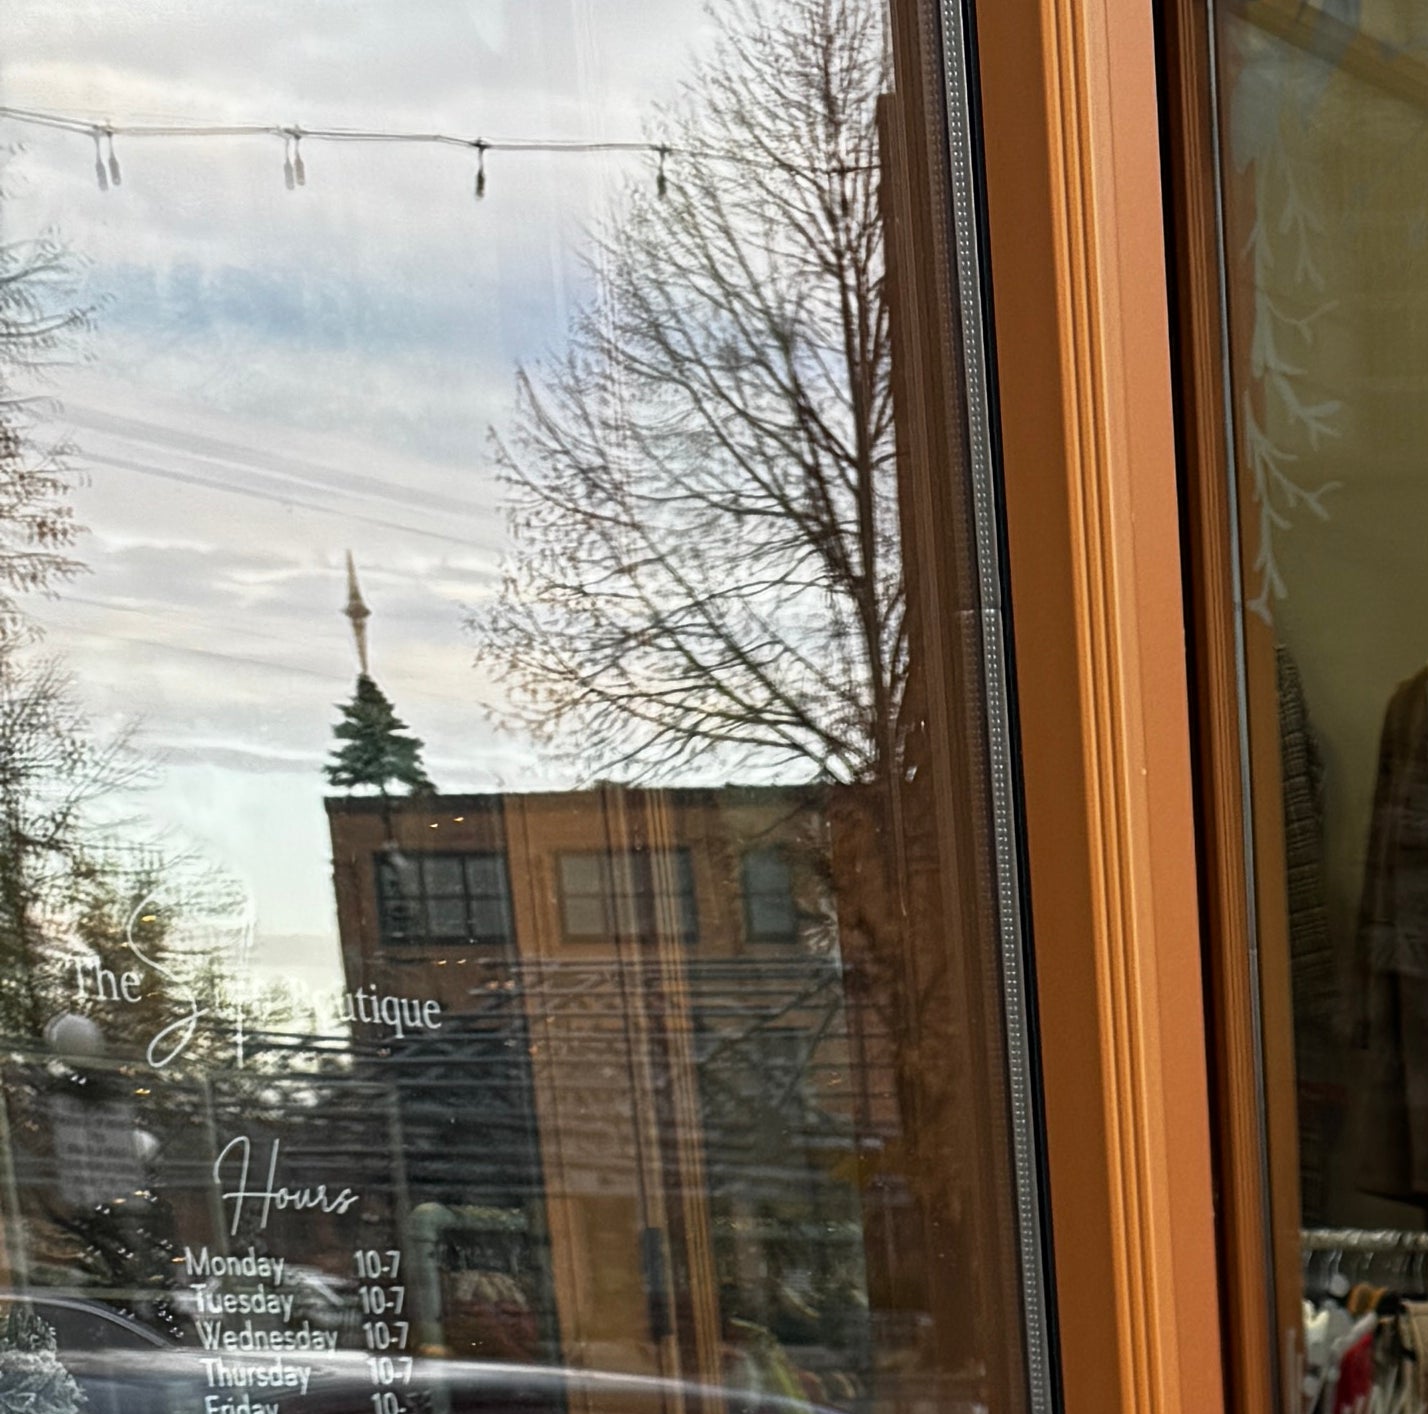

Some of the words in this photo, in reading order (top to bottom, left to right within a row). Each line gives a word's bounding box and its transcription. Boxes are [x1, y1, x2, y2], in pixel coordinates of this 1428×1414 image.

[72, 955, 142, 1003] The
[213, 1136, 359, 1236] Hours
[185, 1246, 284, 1285] Monday
[354, 1250, 400, 1279] 10-7
[190, 1284, 294, 1323] Tuesday
[359, 1286, 404, 1315] 10-7
[197, 1319, 338, 1359] Wednesday
[363, 1321, 409, 1350] 10-7
[200, 1356, 311, 1395] Thursday
[367, 1356, 413, 1385] 10-7
